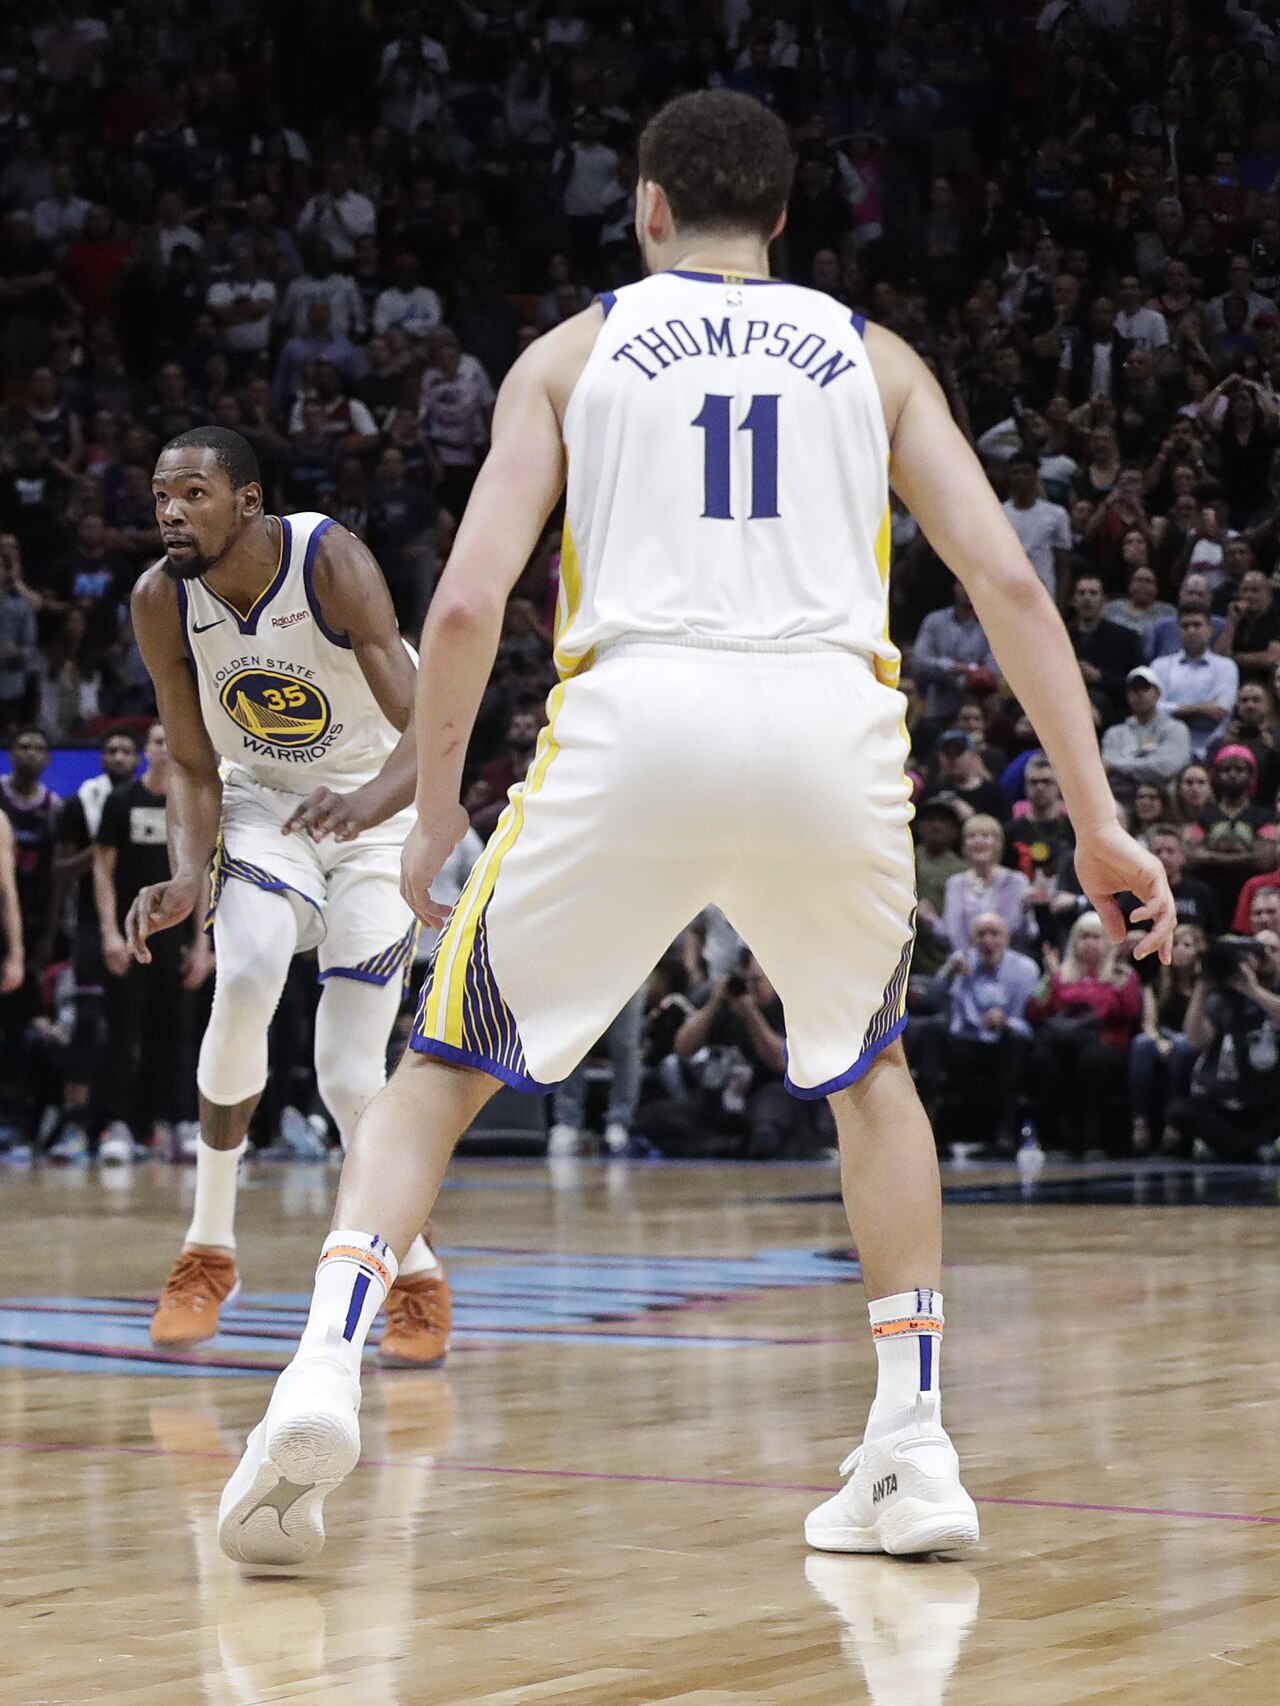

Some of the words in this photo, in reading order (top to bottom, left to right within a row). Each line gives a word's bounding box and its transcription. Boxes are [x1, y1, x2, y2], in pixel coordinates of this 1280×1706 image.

[612, 317, 856, 388] THOMPSON
[690, 393, 782, 520] 11
[271, 610, 310, 628] Rakuten
[266, 659, 316, 680] STATE
[262, 684, 307, 711] 35
[242, 722, 344, 763] WARRIORS
[873, 1473, 898, 1505] ANTA
